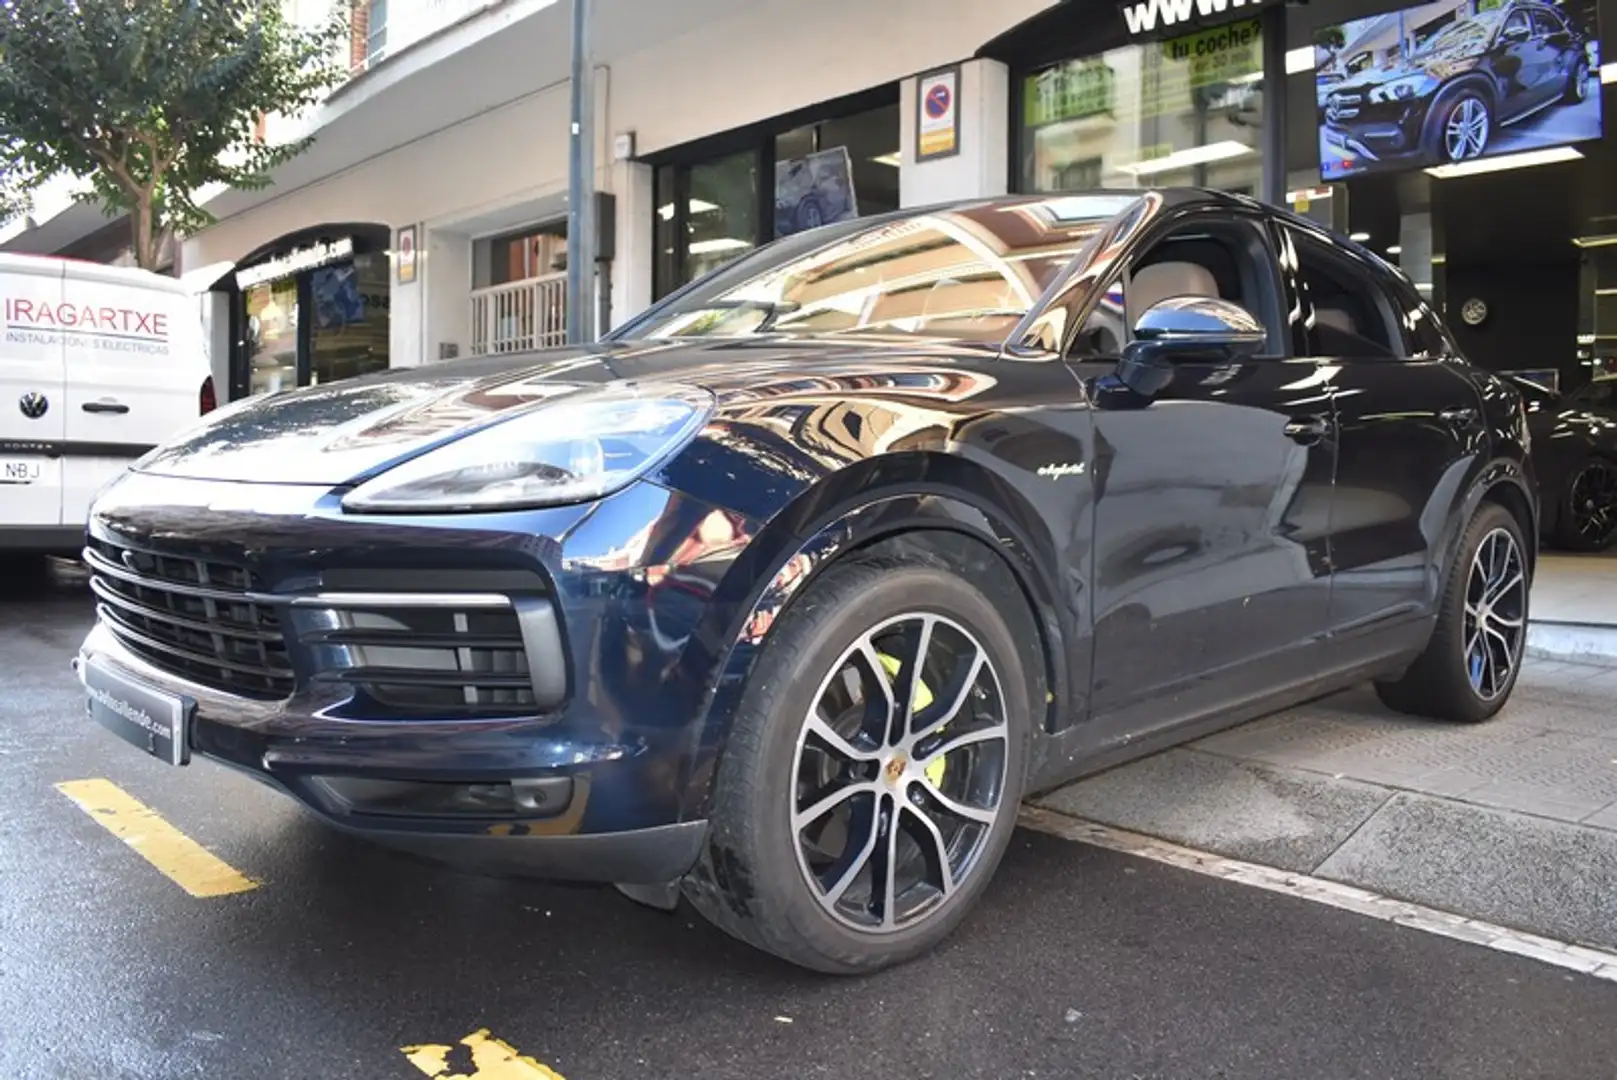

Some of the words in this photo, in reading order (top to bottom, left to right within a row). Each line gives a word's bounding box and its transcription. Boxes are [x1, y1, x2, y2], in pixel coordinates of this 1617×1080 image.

[6, 298, 168, 336] IRAGARTXE
[6, 332, 99, 349] INSTALACIONS
[6, 463, 40, 478] NBJ
